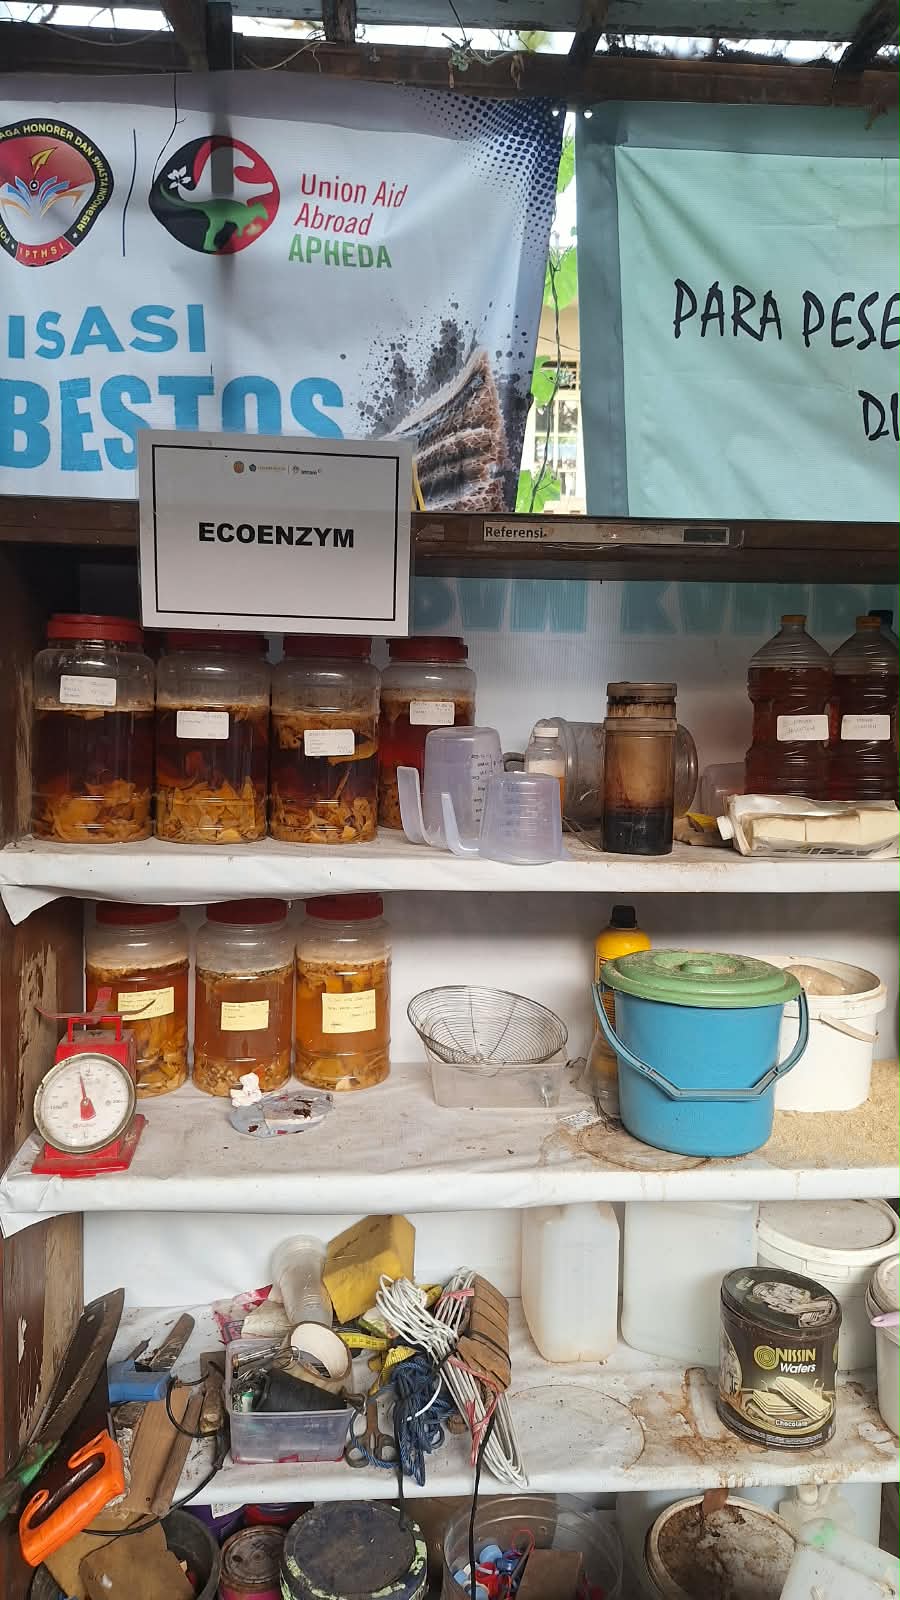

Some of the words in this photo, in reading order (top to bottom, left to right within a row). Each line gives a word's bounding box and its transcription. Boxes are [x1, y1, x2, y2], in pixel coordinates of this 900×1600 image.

[23, 123, 74, 141] HONORER
[75, 136, 94, 156] DAN
[301, 173, 367, 204] Union
[372, 181, 408, 208] Aid
[293, 202, 374, 236] Abroad
[288, 233, 393, 269] APHEDA
[673, 278, 782, 342] PARA
[8, 304, 206, 360] ISASI
[198, 522, 355, 549] ECOENZYM
[775, 1347, 817, 1362] NISSIN
[780, 1362, 817, 1374] Wafers
